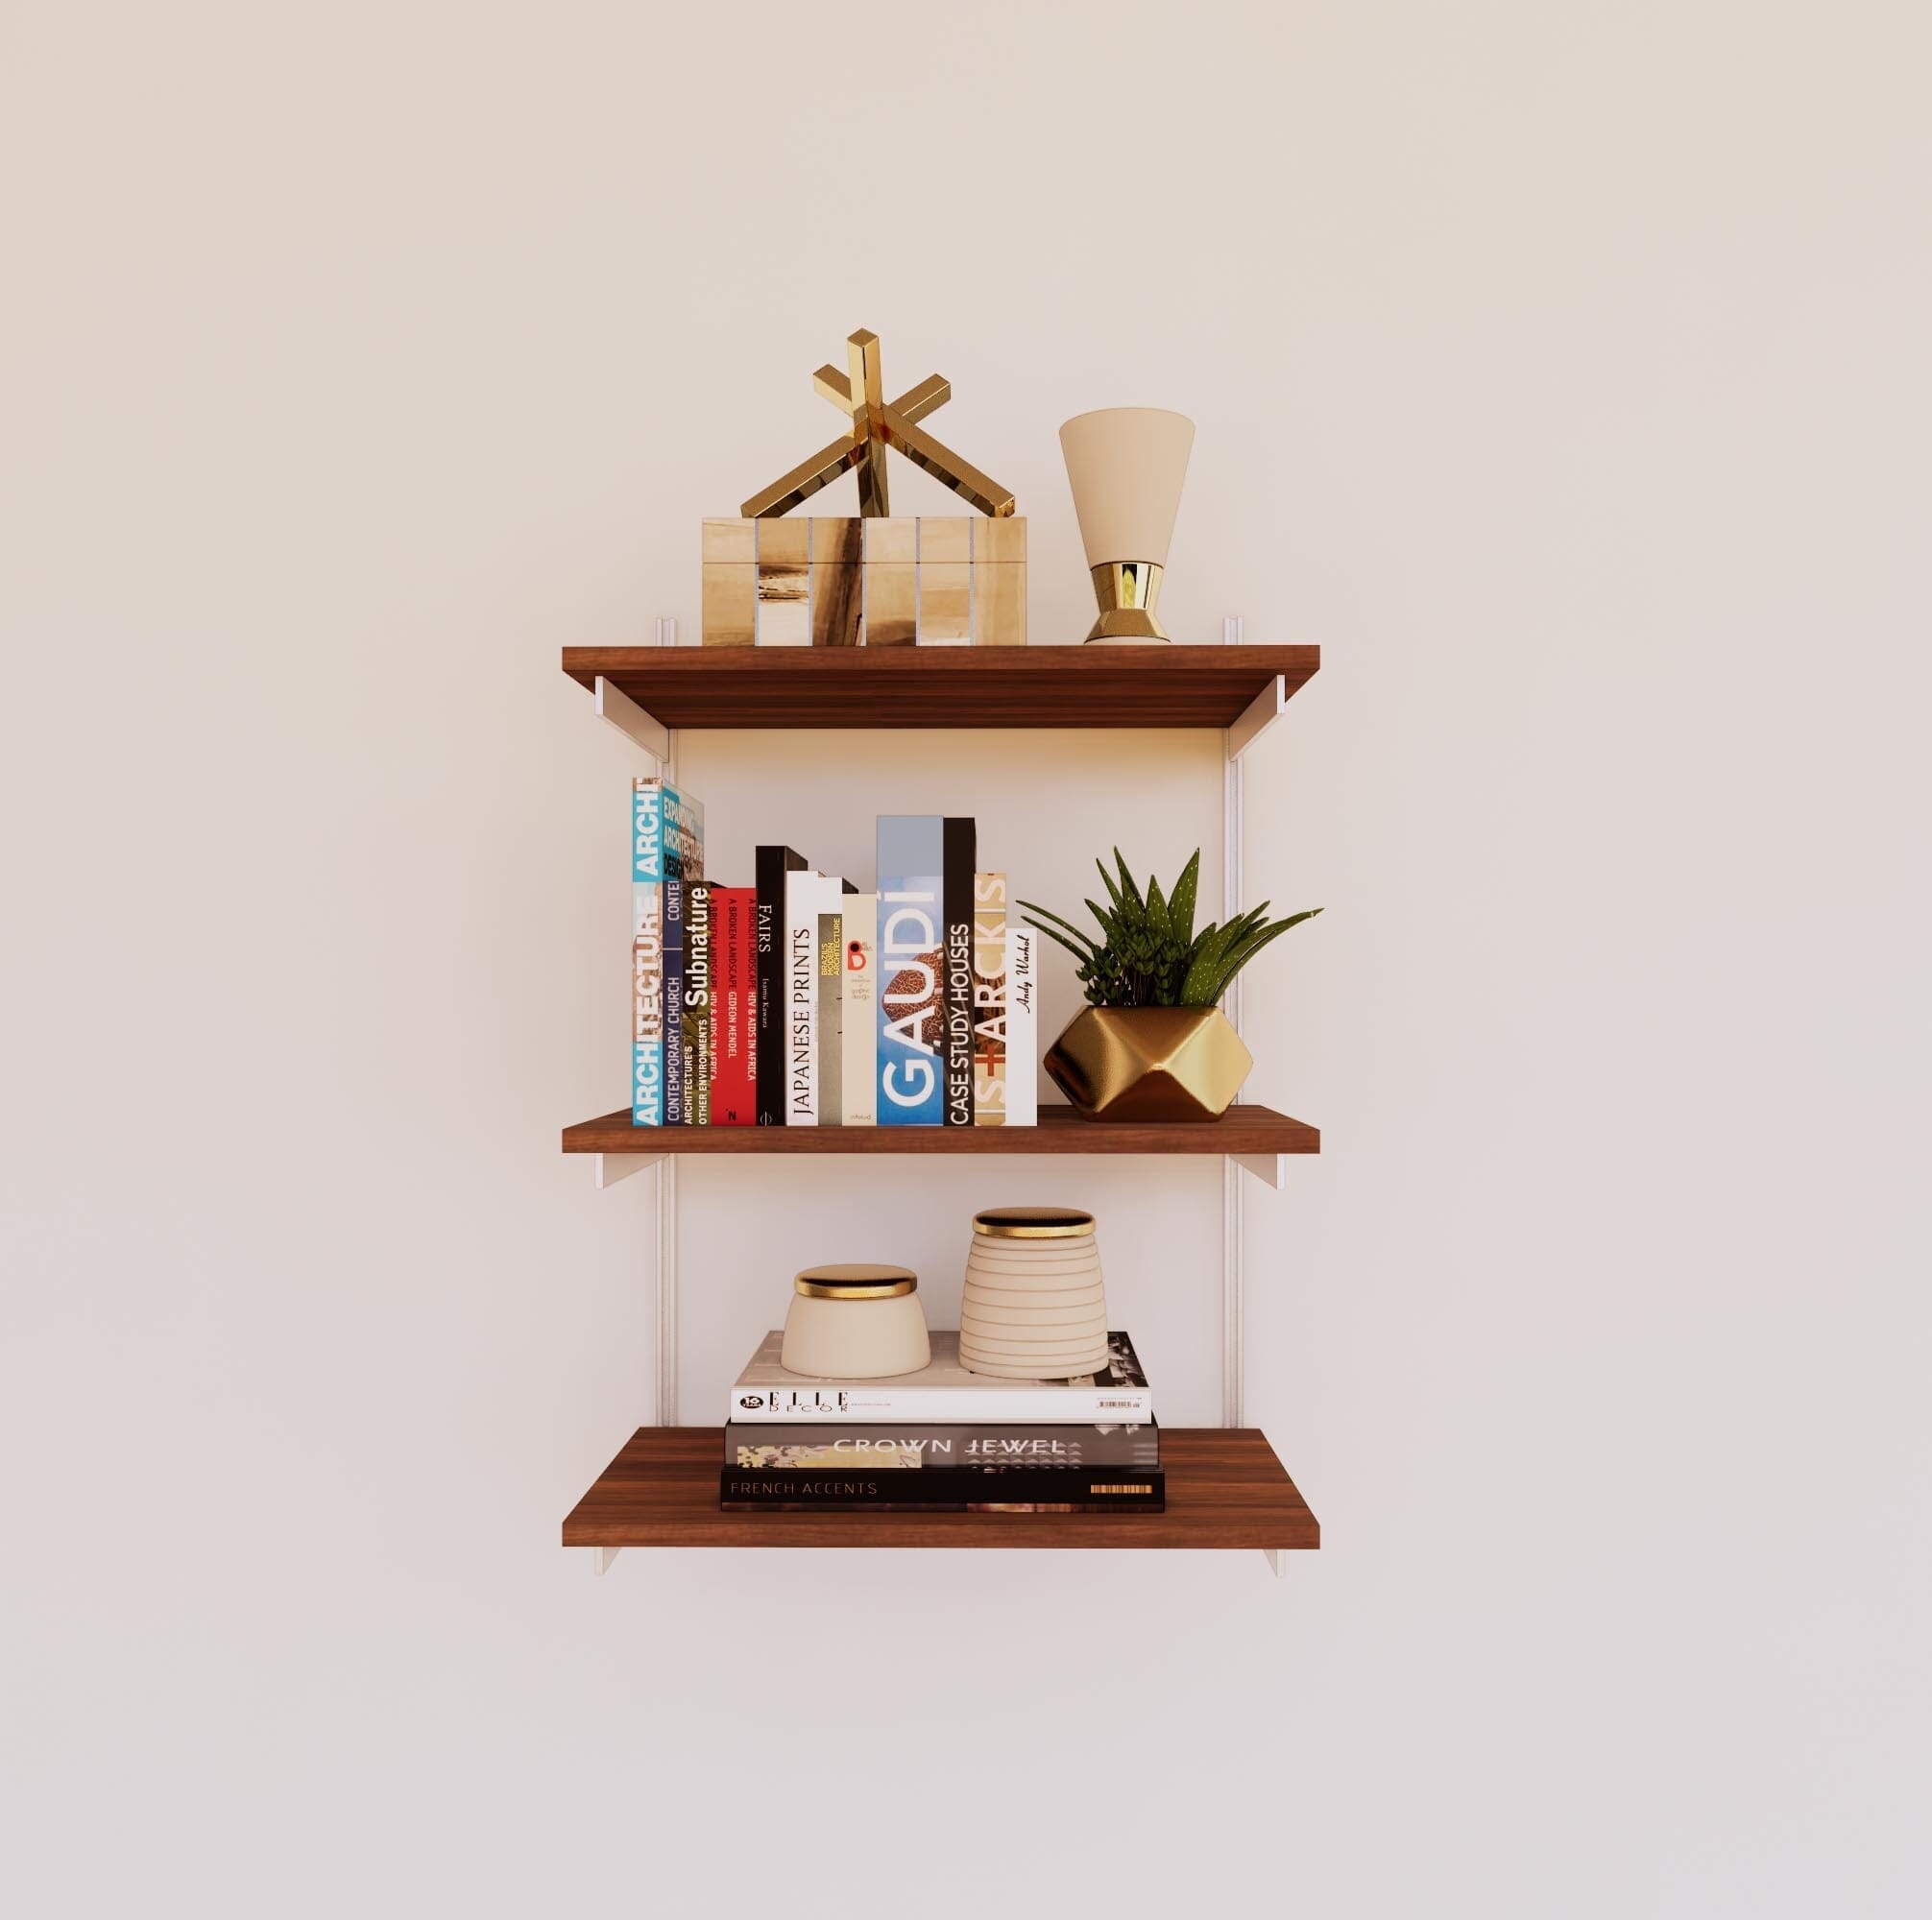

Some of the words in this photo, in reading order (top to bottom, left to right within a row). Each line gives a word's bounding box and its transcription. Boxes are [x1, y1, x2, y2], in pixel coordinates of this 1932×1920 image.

[636, 777, 659, 876] ARCHI
[664, 825, 703, 862] ARCHITECTURE
[685, 887, 709, 1007] Subnature
[728, 906, 737, 940] BROKEN
[759, 904, 772, 952] FAIRS
[728, 942, 737, 990] LANDSCAPE
[793, 928, 809, 1004] PRINTS
[950, 924, 969, 1001] HOUSES
[1015, 934, 1030, 975] Warhol
[636, 895, 659, 1126] ARCHITECTURE
[667, 977, 680, 1024] CHURCH
[728, 991, 737, 1023] GIDEON
[1016, 981, 1033, 1014] Andy
[698, 1019, 708, 1090] ENVIRONMENTS
[728, 1024, 737, 1059] MENDEL
[748, 1039, 756, 1049] IN
[950, 1006, 969, 1068] STUDY
[667, 1027, 680, 1121] CONTEMPORARY
[684, 1045, 693, 1125] ARCHITECTURE'S
[793, 1012, 814, 1115] JAPANESE
[698, 1093, 708, 1125] OTHER
[950, 1074, 969, 1125] CASE
[769, 1392, 849, 1405] ELLE
[833, 1439, 953, 1453] CROWN
[964, 1439, 1067, 1453] JEWEL
[731, 1482, 795, 1495] FRENCH
[802, 1482, 878, 1495] ACCENTS
